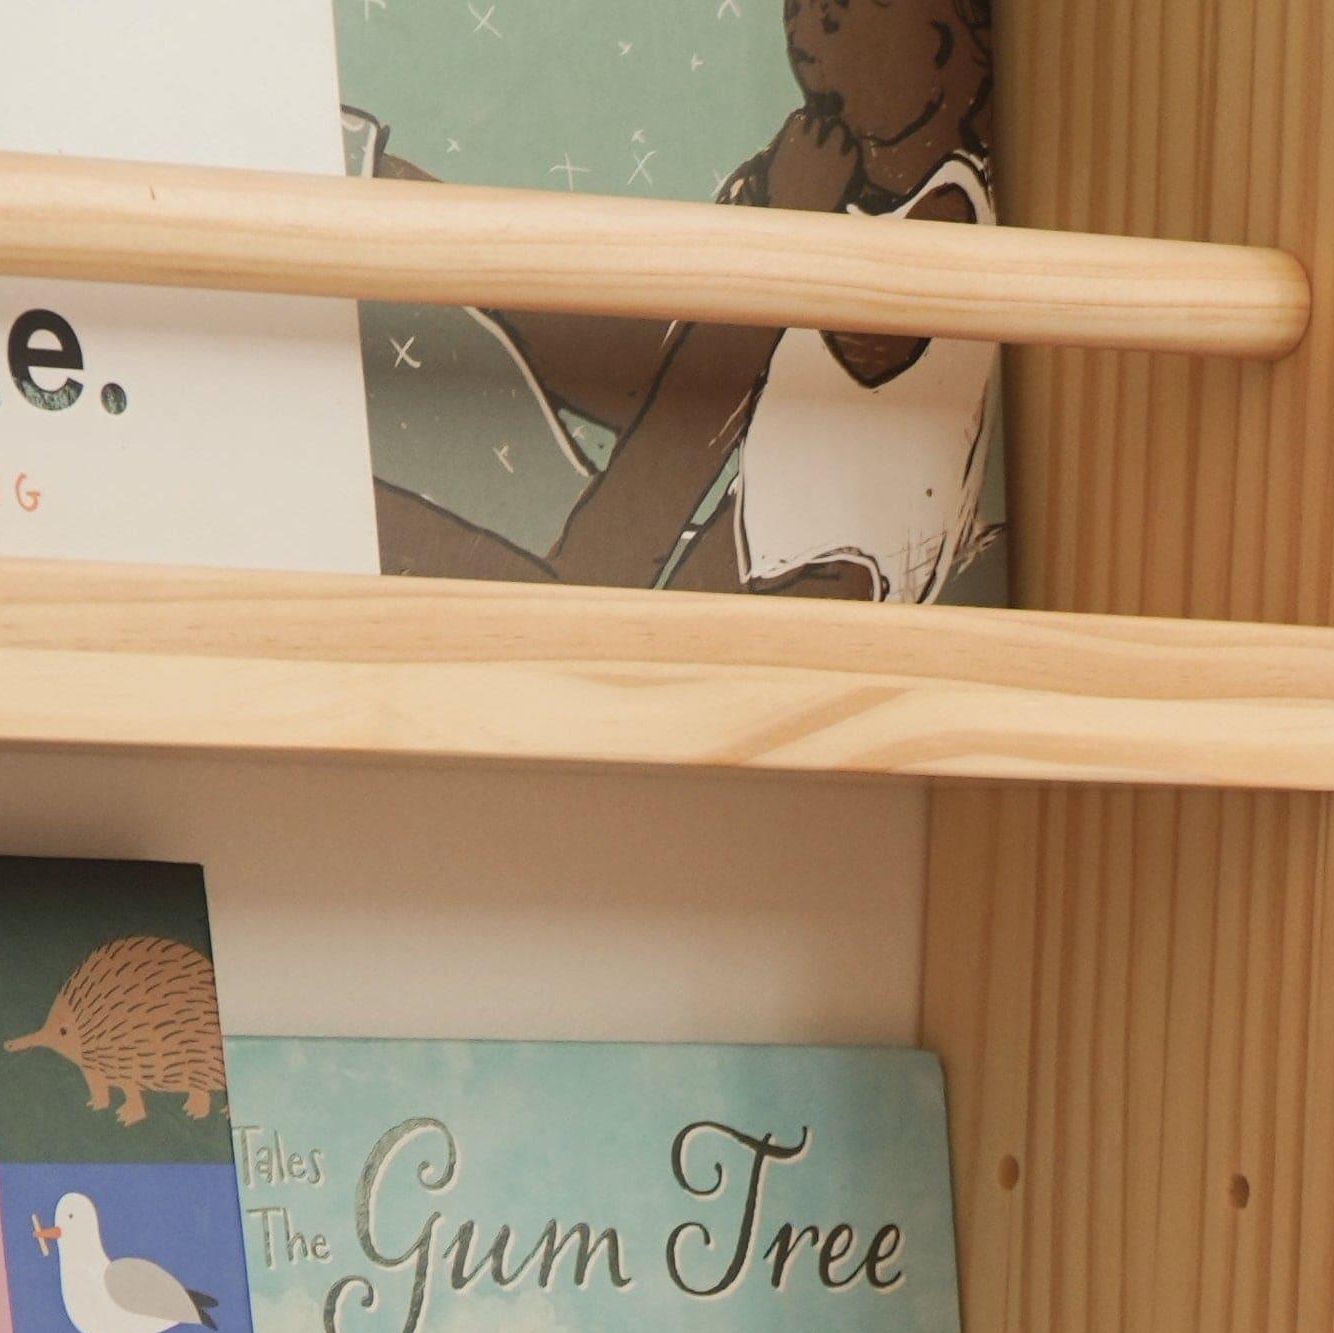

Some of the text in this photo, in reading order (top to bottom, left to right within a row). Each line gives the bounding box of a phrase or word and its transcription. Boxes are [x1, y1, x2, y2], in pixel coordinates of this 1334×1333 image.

[232, 1125, 323, 1187] Tales
[246, 1206, 331, 1269] The
[666, 1120, 903, 1298] Tree
